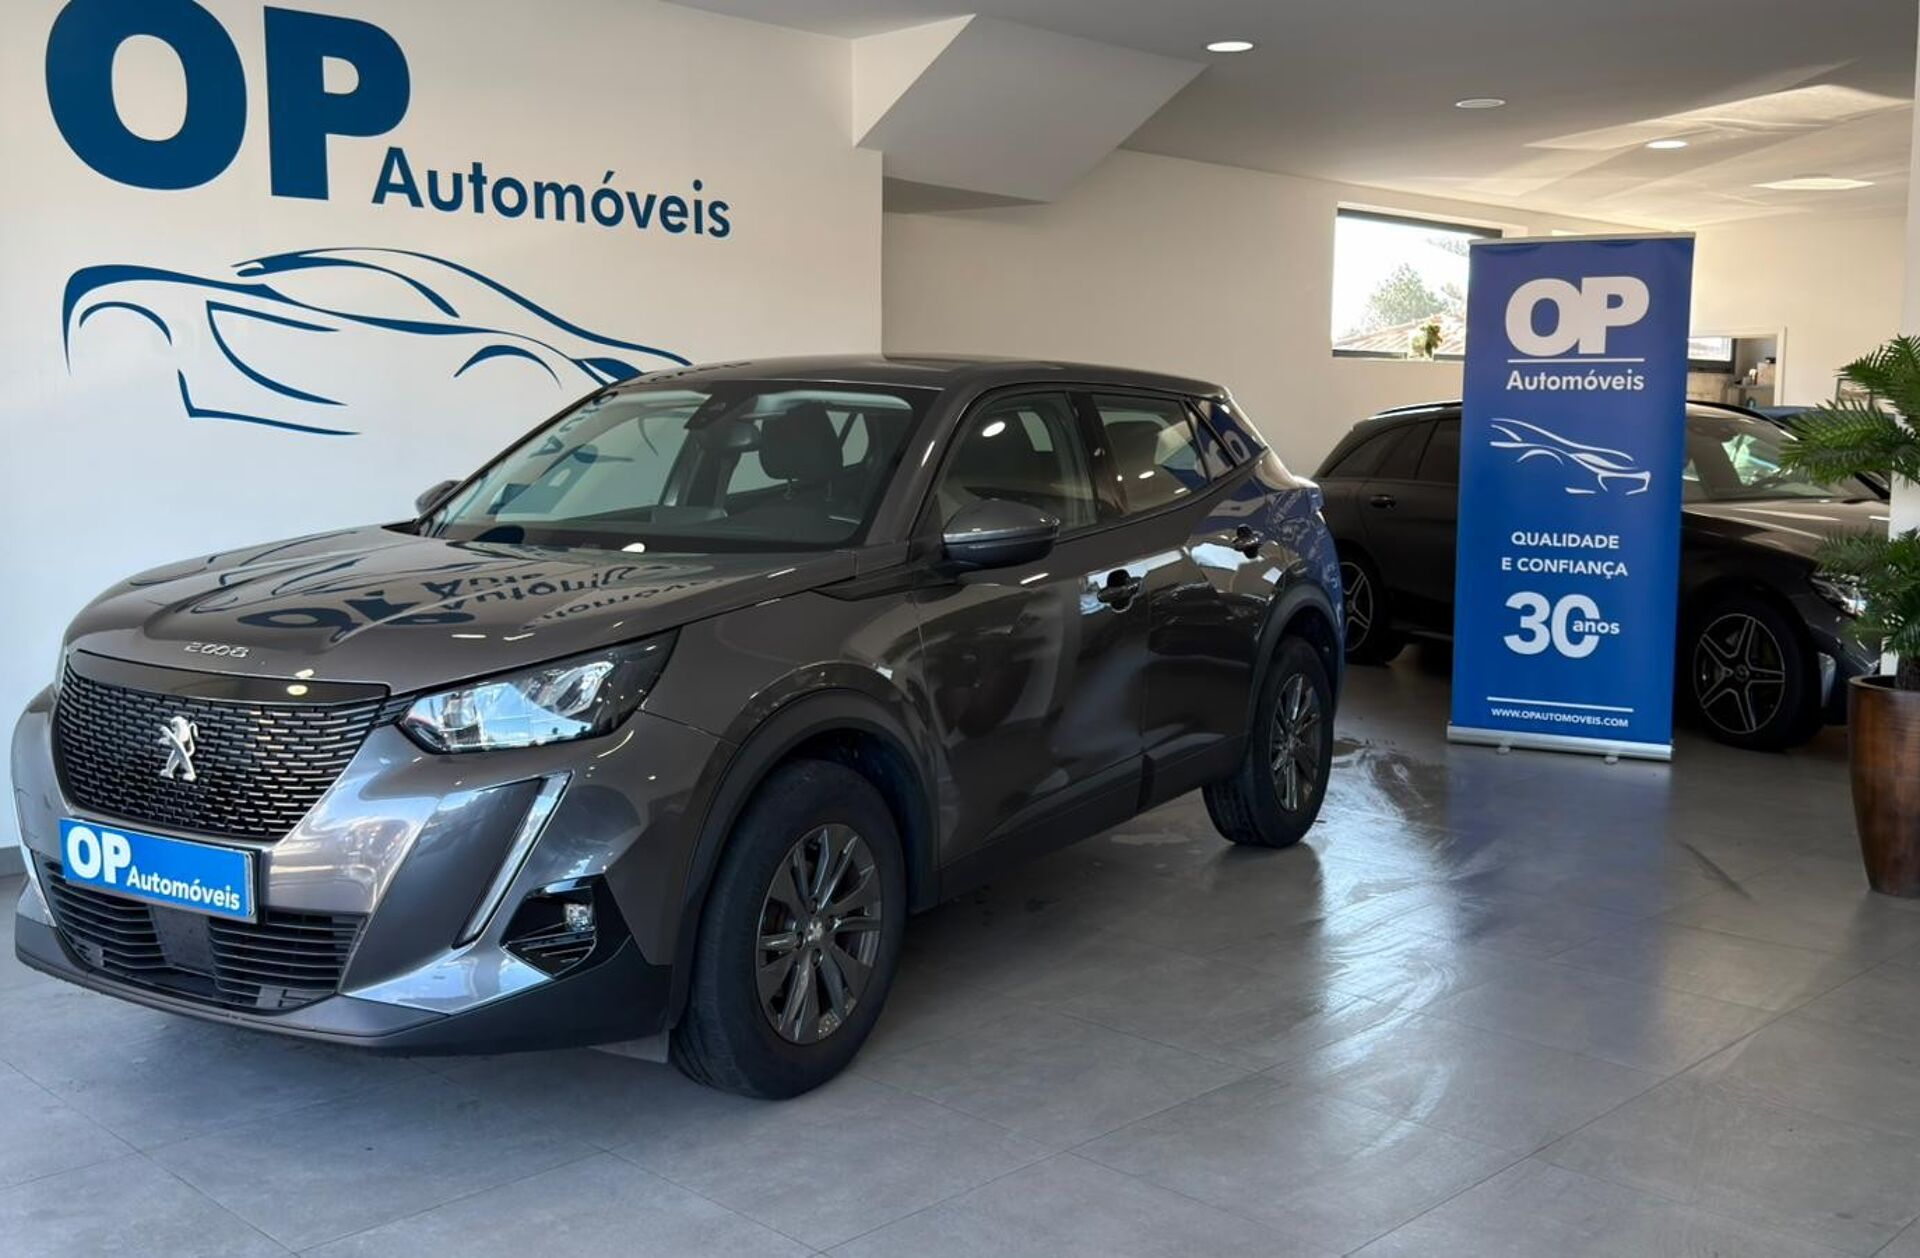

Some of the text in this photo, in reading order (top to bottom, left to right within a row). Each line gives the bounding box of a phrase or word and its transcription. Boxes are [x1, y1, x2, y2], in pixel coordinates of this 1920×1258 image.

[45, 0, 411, 200] OP
[371, 146, 732, 239] Automóveis
[1505, 275, 1650, 357] OP
[1506, 369, 1645, 391] Automóveis
[1511, 531, 1619, 548] QUALIDADE
[1501, 557, 1628, 578] E CONFIANÇA
[1504, 591, 1620, 658] 30 anos
[1491, 707, 1629, 727] WWW.OPAUTOMOVEIS.COM
[66, 825, 132, 884] OP
[126, 866, 241, 910] Automóveis
